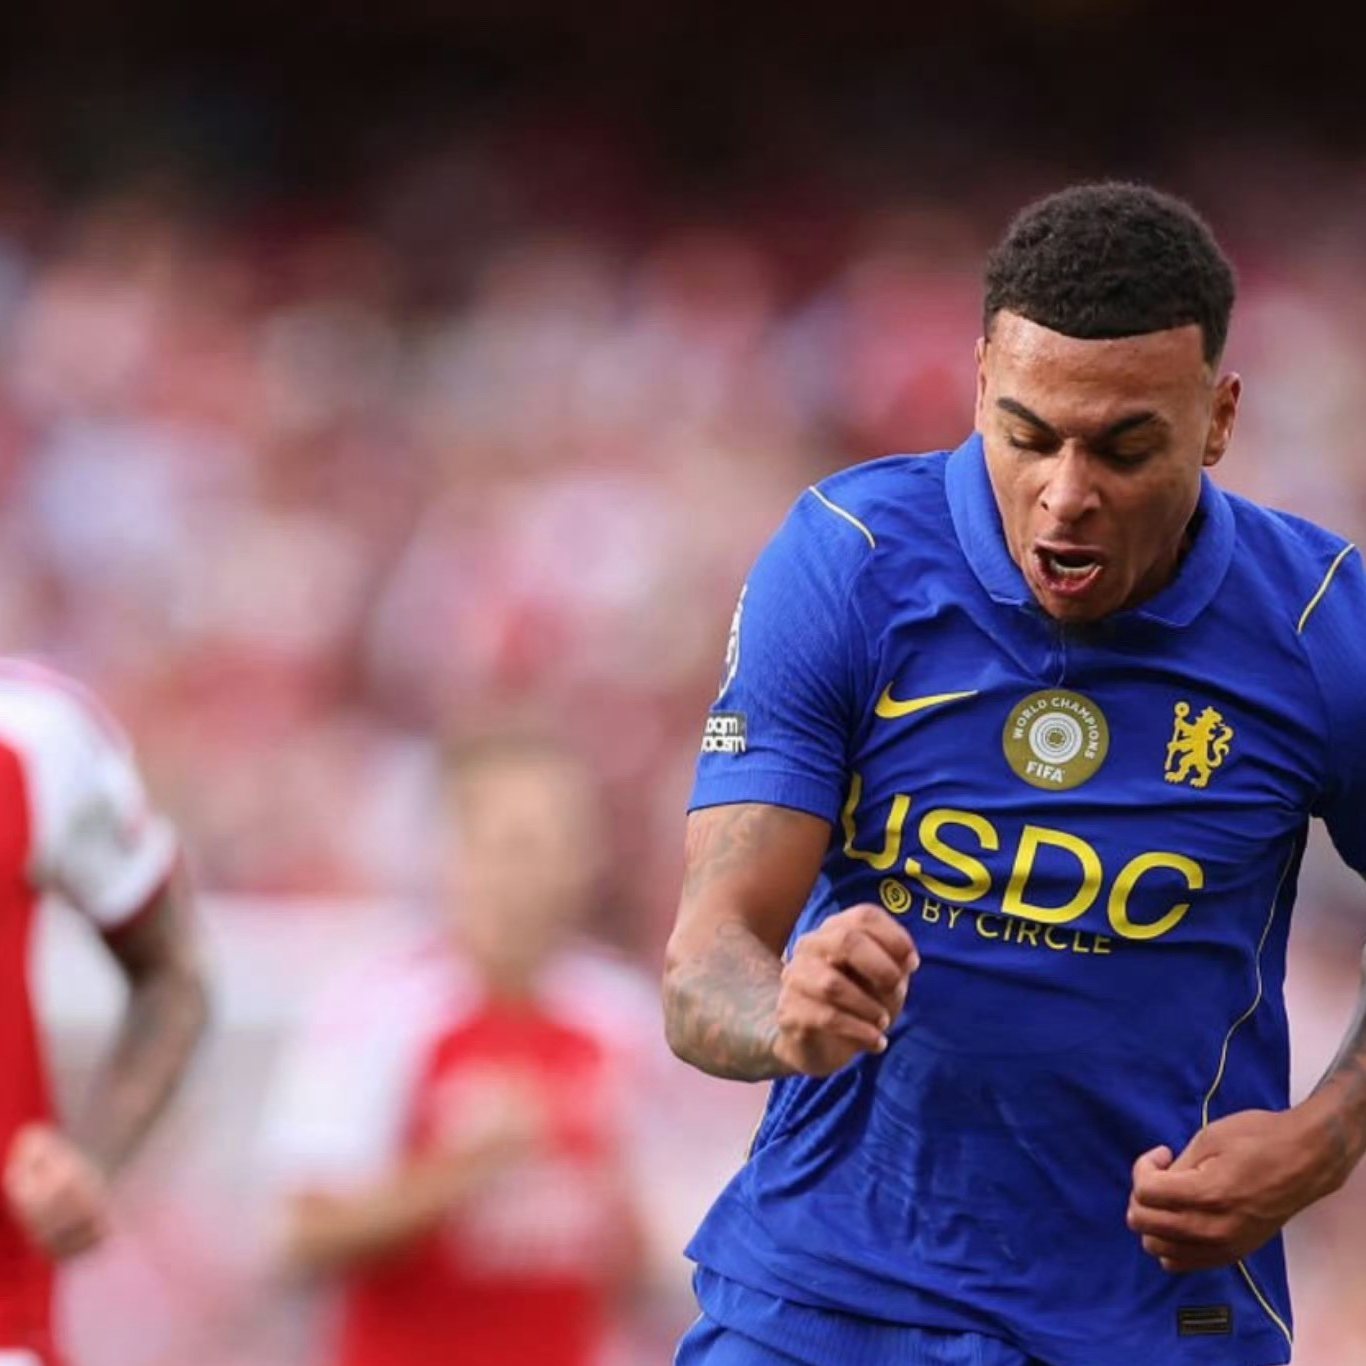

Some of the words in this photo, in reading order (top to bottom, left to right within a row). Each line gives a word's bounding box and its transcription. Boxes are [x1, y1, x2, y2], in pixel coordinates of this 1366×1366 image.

[1013, 699, 1047, 739] WORLD
[1051, 697, 1100, 760] CHAMPIONS
[1026, 760, 1063, 783] FIFA
[842, 771, 1205, 940] USDC
[921, 897, 964, 930] BY
[975, 912, 1112, 954] CIRCLE
